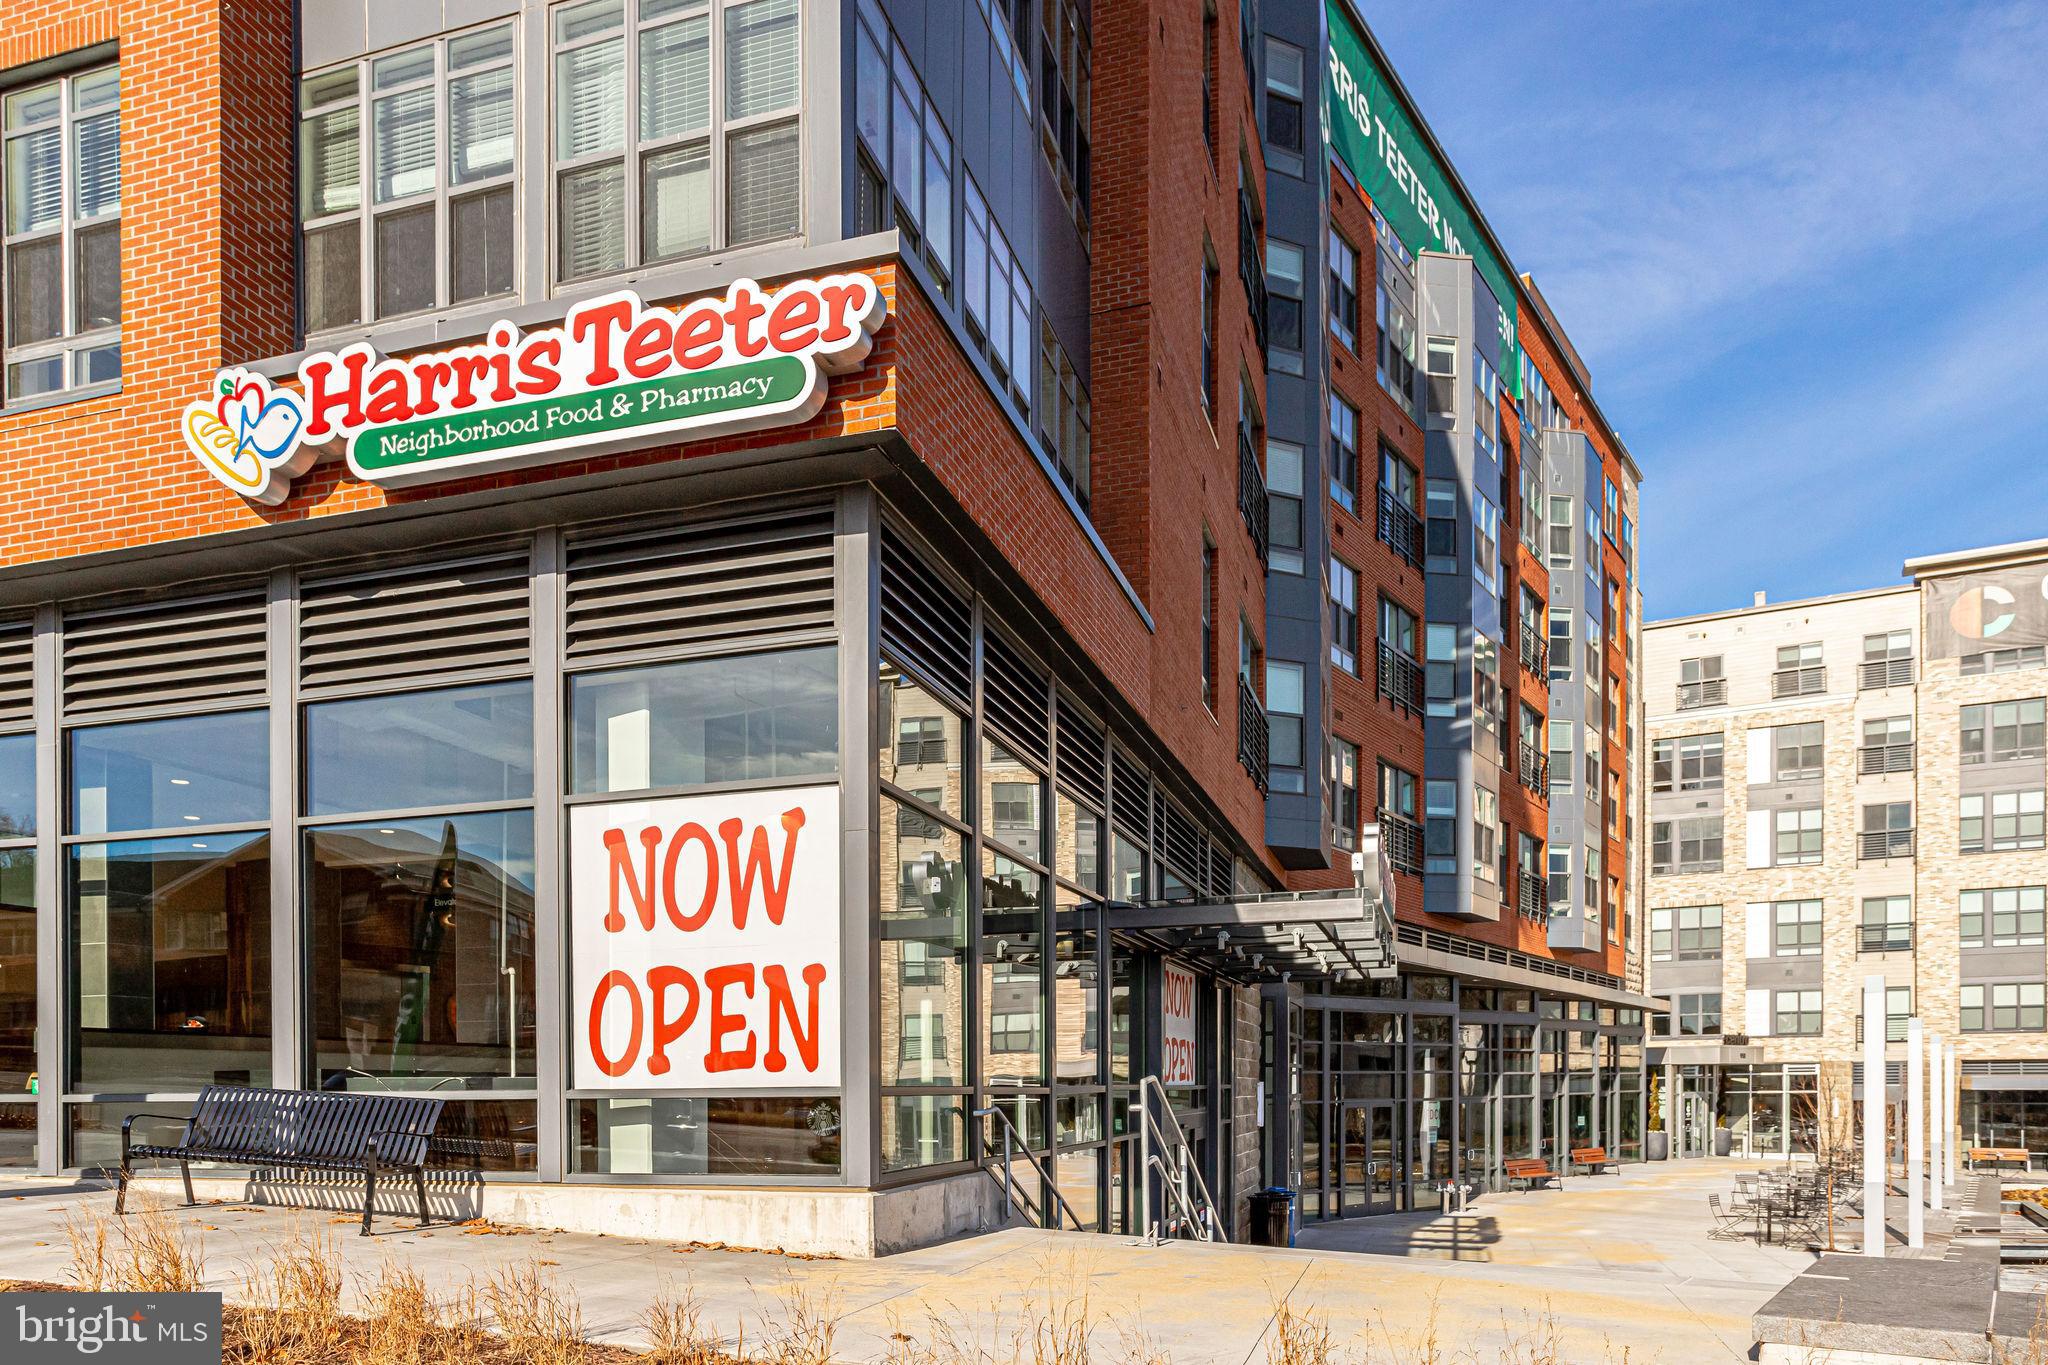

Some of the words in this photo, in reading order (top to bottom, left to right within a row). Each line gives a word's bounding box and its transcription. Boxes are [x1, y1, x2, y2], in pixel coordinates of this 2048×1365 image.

[1375, 114, 1441, 240] TEETER
[1443, 216, 1466, 256] NO
[306, 330, 562, 436] Harris
[573, 284, 867, 387] Teeter
[380, 409, 539, 457] Neighborhood
[546, 397, 603, 429] Food
[610, 392, 634, 417] &
[641, 376, 774, 413] Pharmacy
[603, 806, 806, 933] NOW
[589, 962, 827, 1078] OPEN
[1165, 969, 1193, 1018] NOW
[1164, 1037, 1195, 1082] OPEN
